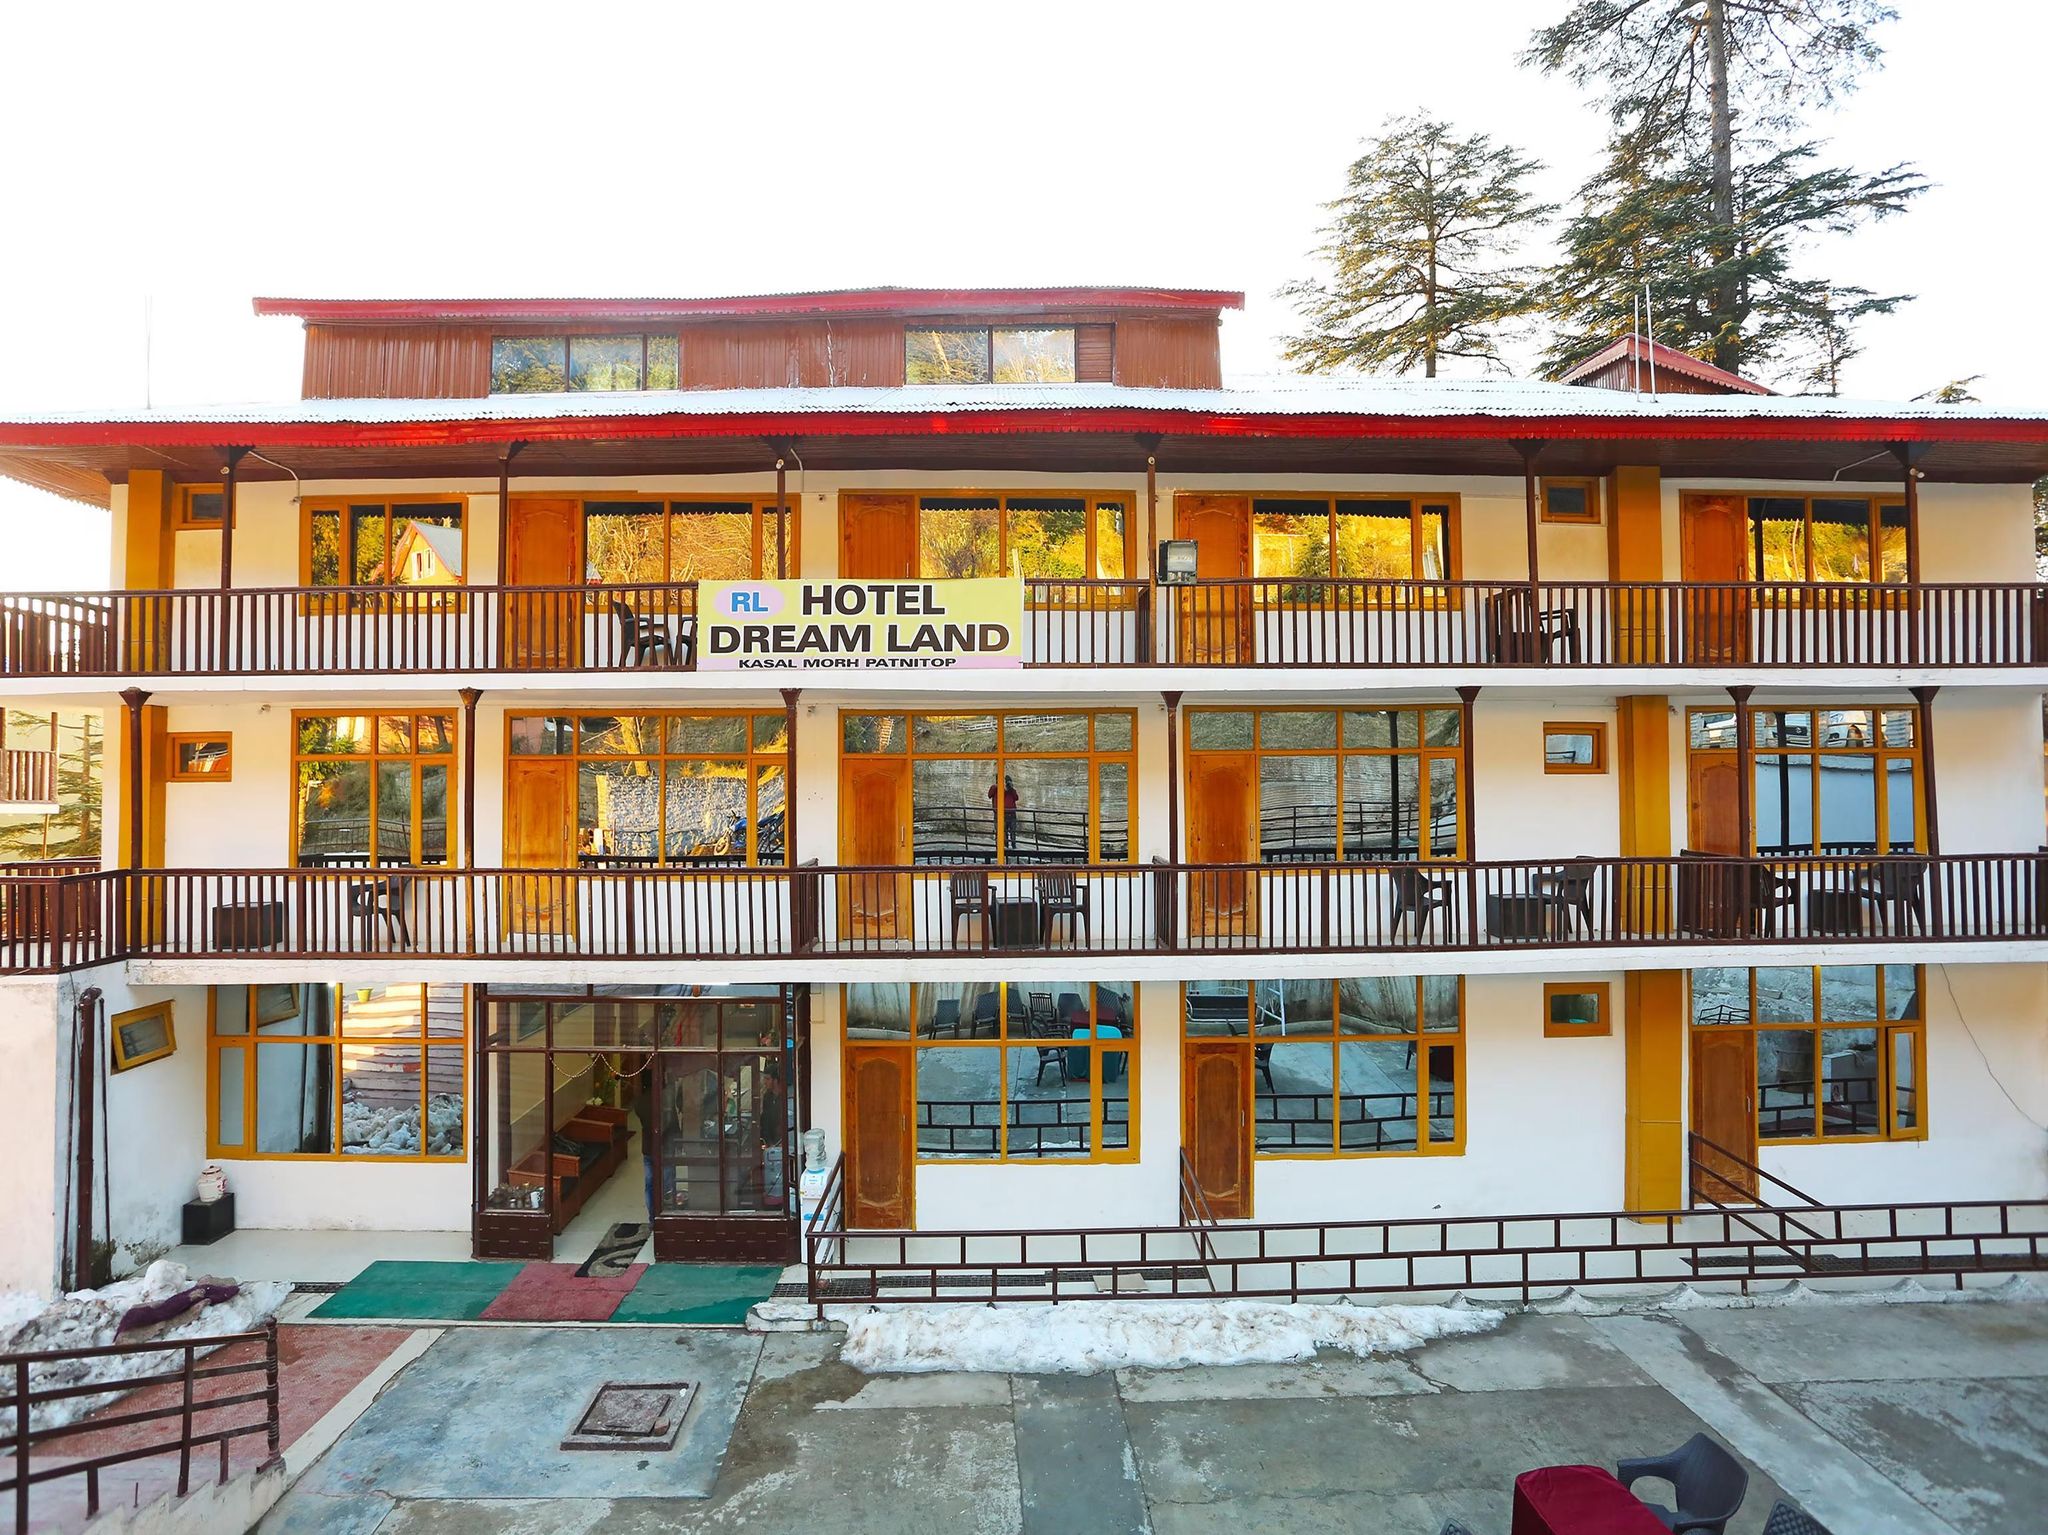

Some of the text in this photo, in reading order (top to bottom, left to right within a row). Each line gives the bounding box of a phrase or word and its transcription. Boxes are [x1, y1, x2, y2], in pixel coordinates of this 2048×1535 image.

[731, 592, 768, 612] RL
[802, 584, 945, 615] HOTEL
[710, 624, 1009, 653] DREAM LAND
[738, 657, 957, 669] KASAL MORH PATNITOP
